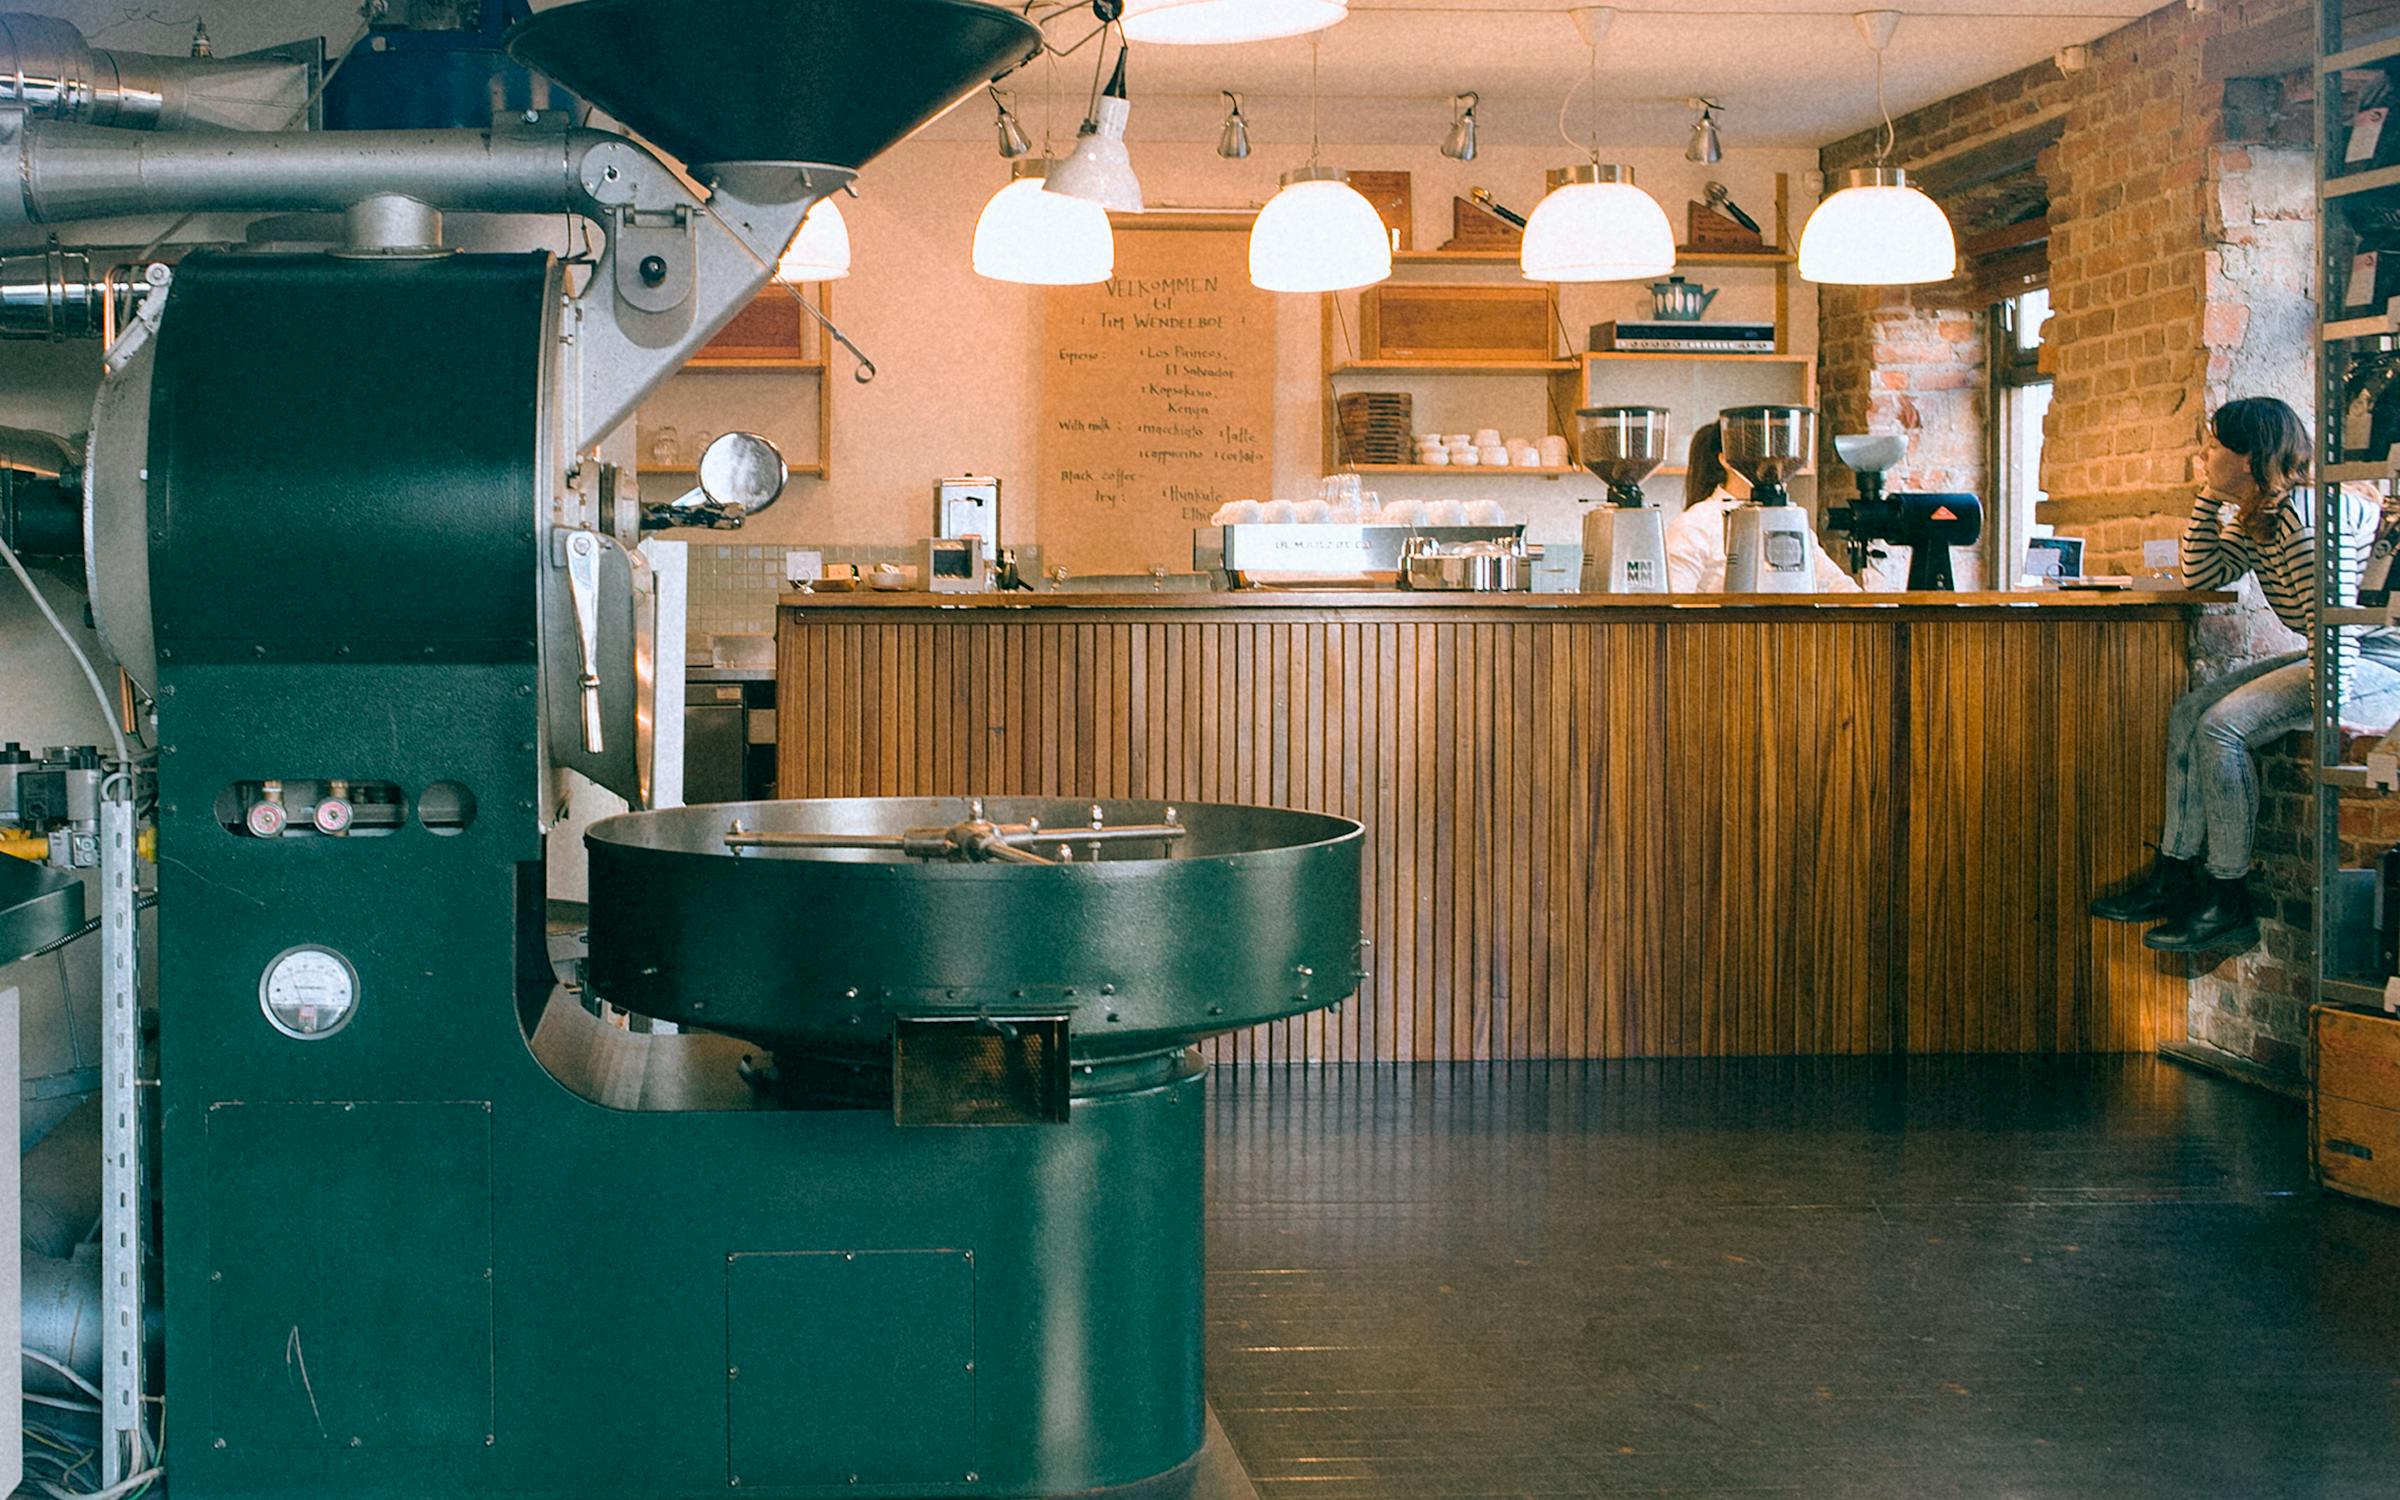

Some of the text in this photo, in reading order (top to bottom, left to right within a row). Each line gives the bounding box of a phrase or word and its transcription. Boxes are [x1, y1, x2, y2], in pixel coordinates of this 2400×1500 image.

[1104, 276, 1219, 297] VELKOMMEN
[1153, 298, 1172, 310] til
[1147, 346, 1170, 359] Los
[1165, 363, 1234, 379] El Salvador
[1168, 402, 1209, 419] Kenya
[1060, 469, 1095, 485] Black
